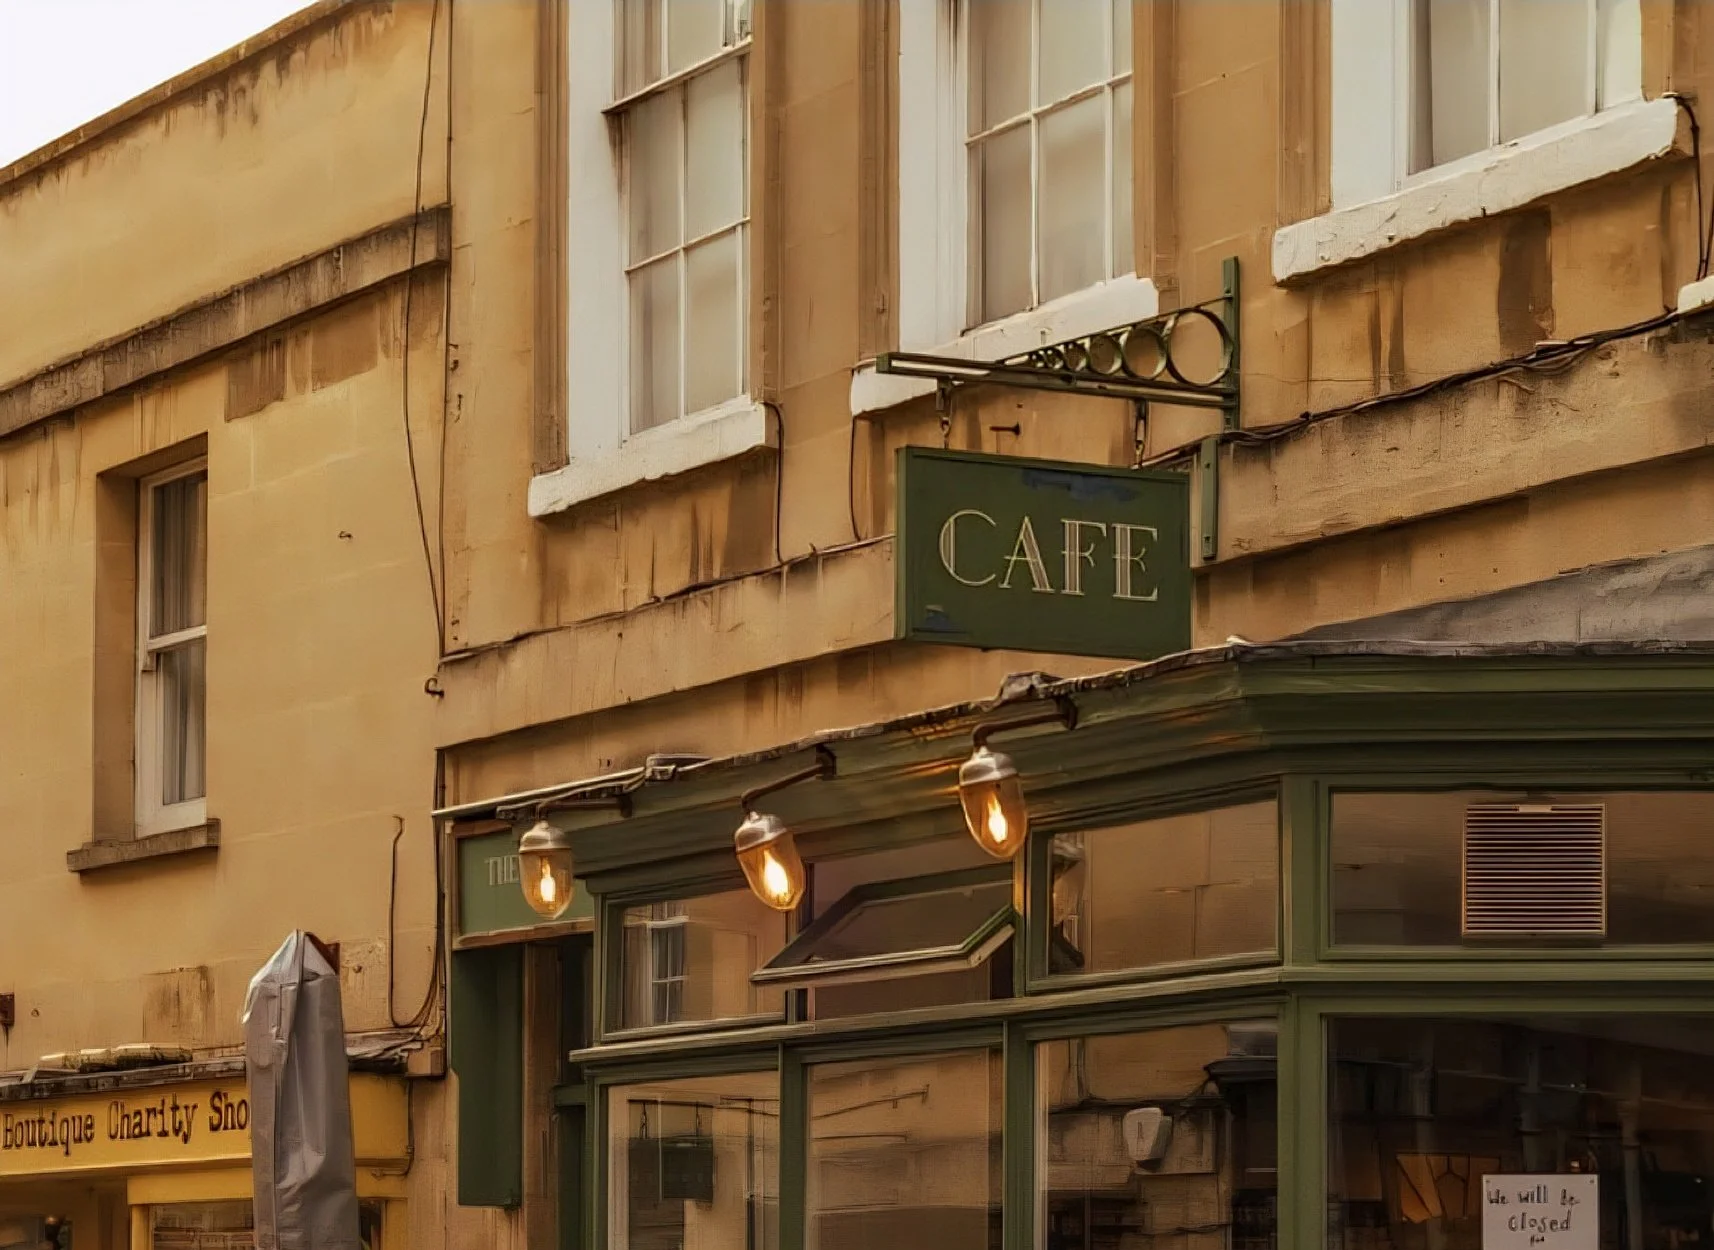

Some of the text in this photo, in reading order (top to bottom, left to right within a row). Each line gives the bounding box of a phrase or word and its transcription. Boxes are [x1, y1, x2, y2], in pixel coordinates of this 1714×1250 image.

[939, 508, 1158, 602] CAFE
[2, 1091, 249, 1156] Boutique Charity Sho
[1517, 1184, 1549, 1204] will
